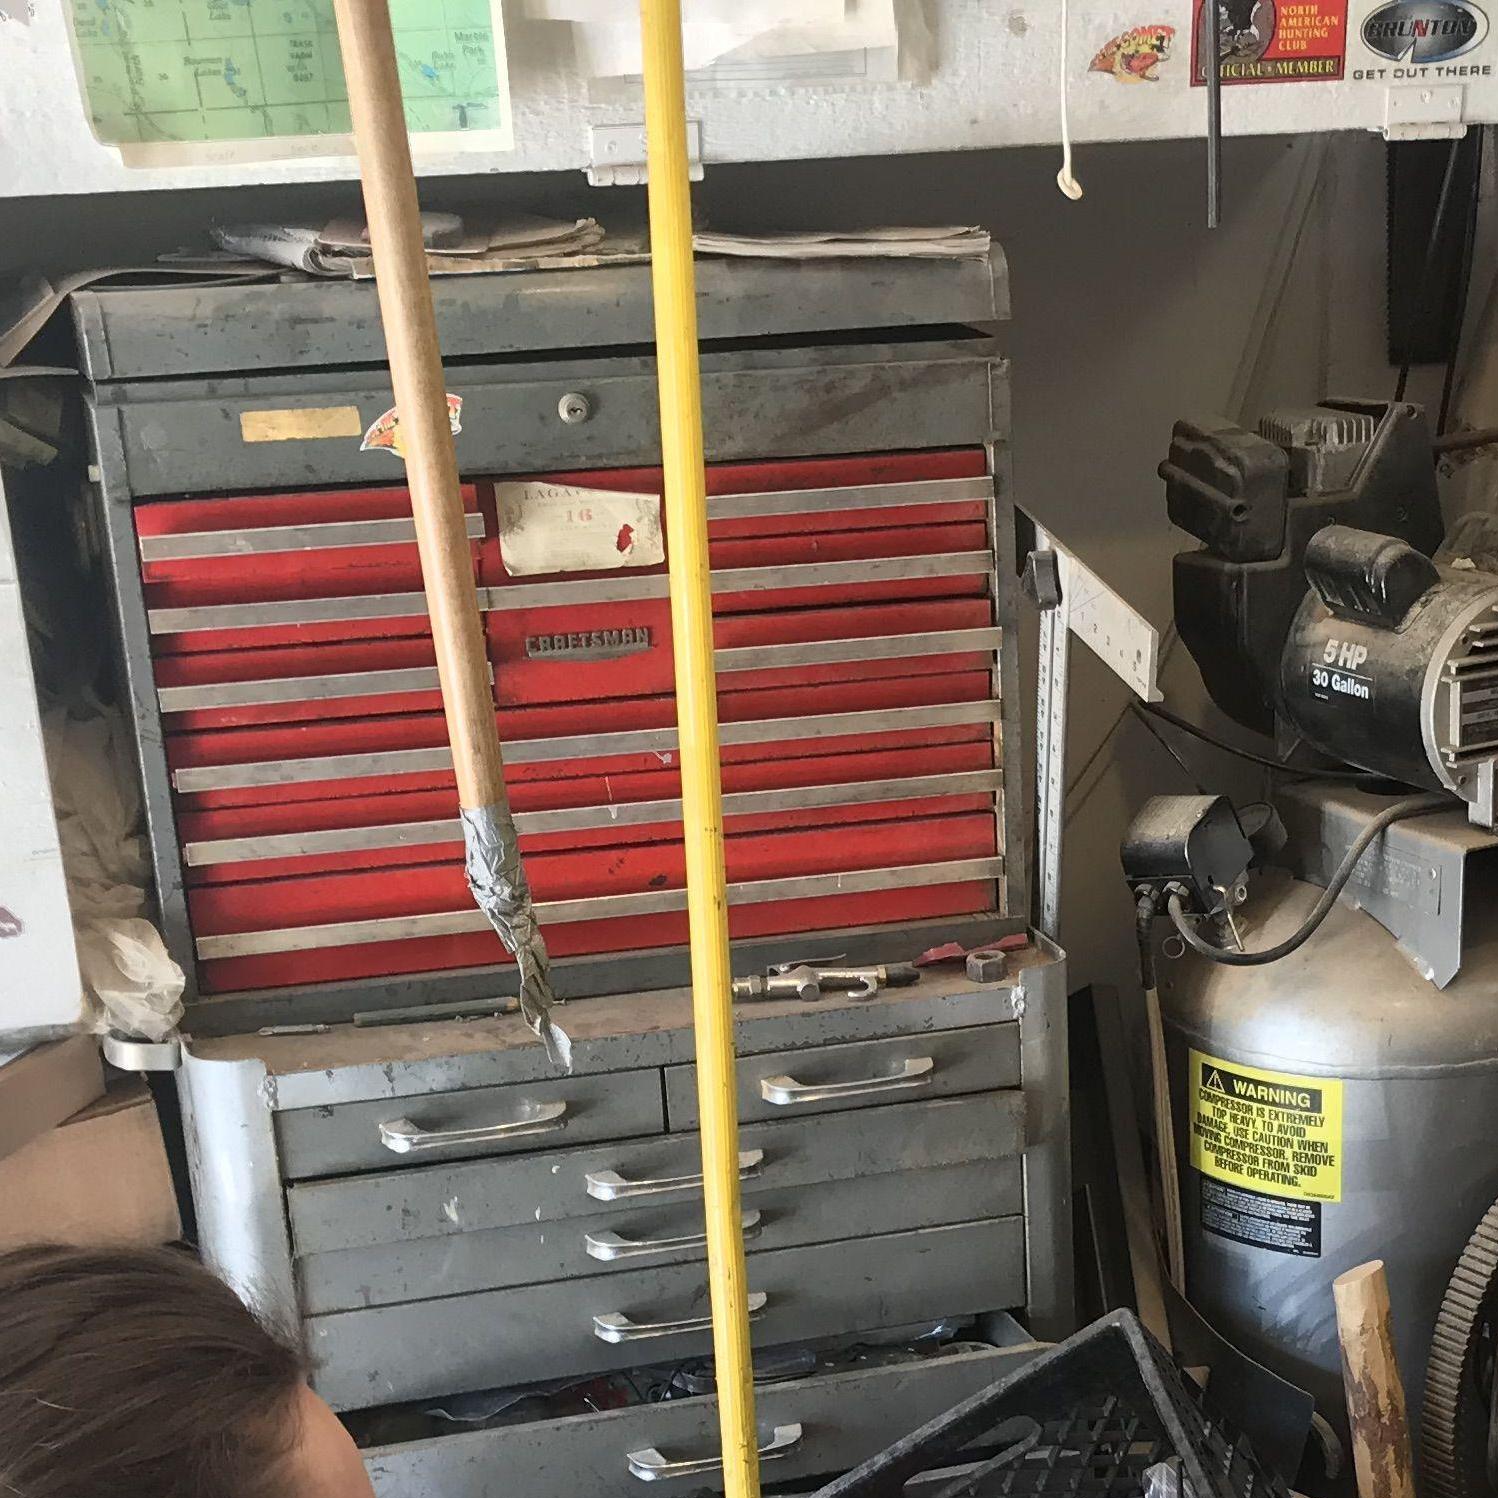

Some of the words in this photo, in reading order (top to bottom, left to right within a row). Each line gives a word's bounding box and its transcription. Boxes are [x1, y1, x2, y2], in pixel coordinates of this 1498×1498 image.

[1279, 15, 1339, 27] AMERICAN
[1280, 5, 1318, 16] NORTH
[1278, 27, 1328, 39] HUNTING
[1366, 19, 1471, 37] BRUNTON
[1278, 40, 1307, 51] CLUB
[1276, 60, 1334, 75] MEMBER
[1353, 69, 1386, 80] GET
[1393, 67, 1428, 79] OUT
[1435, 65, 1492, 77] THERE
[566, 508, 593, 523] 16
[525, 627, 649, 652] CRAFTSMAN
[1323, 638, 1339, 663] 5
[1338, 642, 1368, 670] HP
[1312, 669, 1328, 688] 30
[1331, 673, 1369, 699] Gallon
[1232, 1079, 1311, 1108] WARNING
[1199, 1088, 1254, 1116] COMPRESSOR
[1256, 1106, 1266, 1119] IS
[1268, 1109, 1325, 1128] EXTREMELY
[1212, 1106, 1227, 1120] TOP
[1262, 1120, 1273, 1133] TO
[1276, 1123, 1306, 1139] AVOID
[1193, 1122, 1222, 1143] MOVING
[1292, 1150, 1335, 1167] REMOVE
[1233, 1125, 1250, 1141] USE
[1252, 1130, 1294, 1148] CAUTION
[1297, 1138, 1329, 1153] WHEN
[1203, 1141, 1259, 1168] COMPRESSOR
[1262, 1158, 1290, 1173] FROM
[1293, 1163, 1317, 1177] SKID
[1214, 1156, 1244, 1175] BEFORE
[1246, 1166, 1302, 1188] OPERATING.
